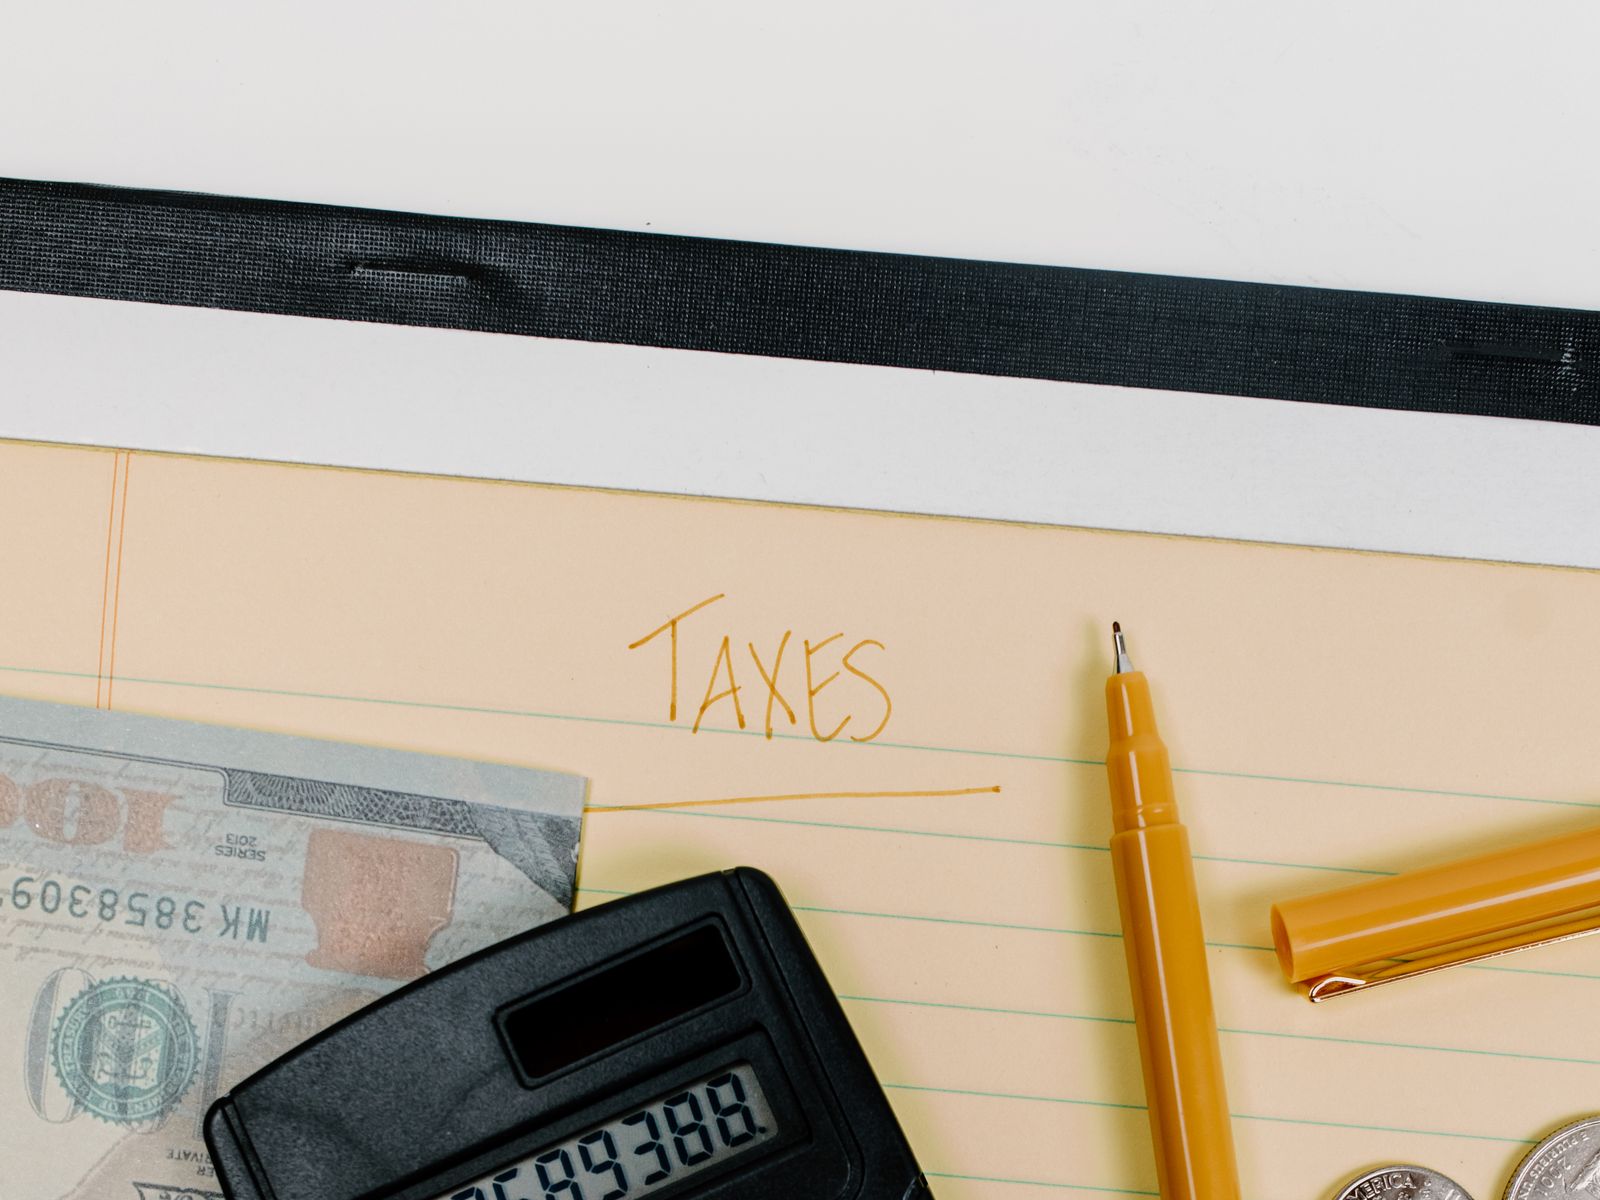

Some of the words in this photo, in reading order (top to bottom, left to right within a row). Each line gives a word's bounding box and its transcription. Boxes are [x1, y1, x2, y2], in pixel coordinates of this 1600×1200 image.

[628, 593, 892, 742] TAXES
[214, 845, 266, 862] SERIES
[219, 904, 271, 943] MK
[1537, 1155, 1573, 1198] 2001
